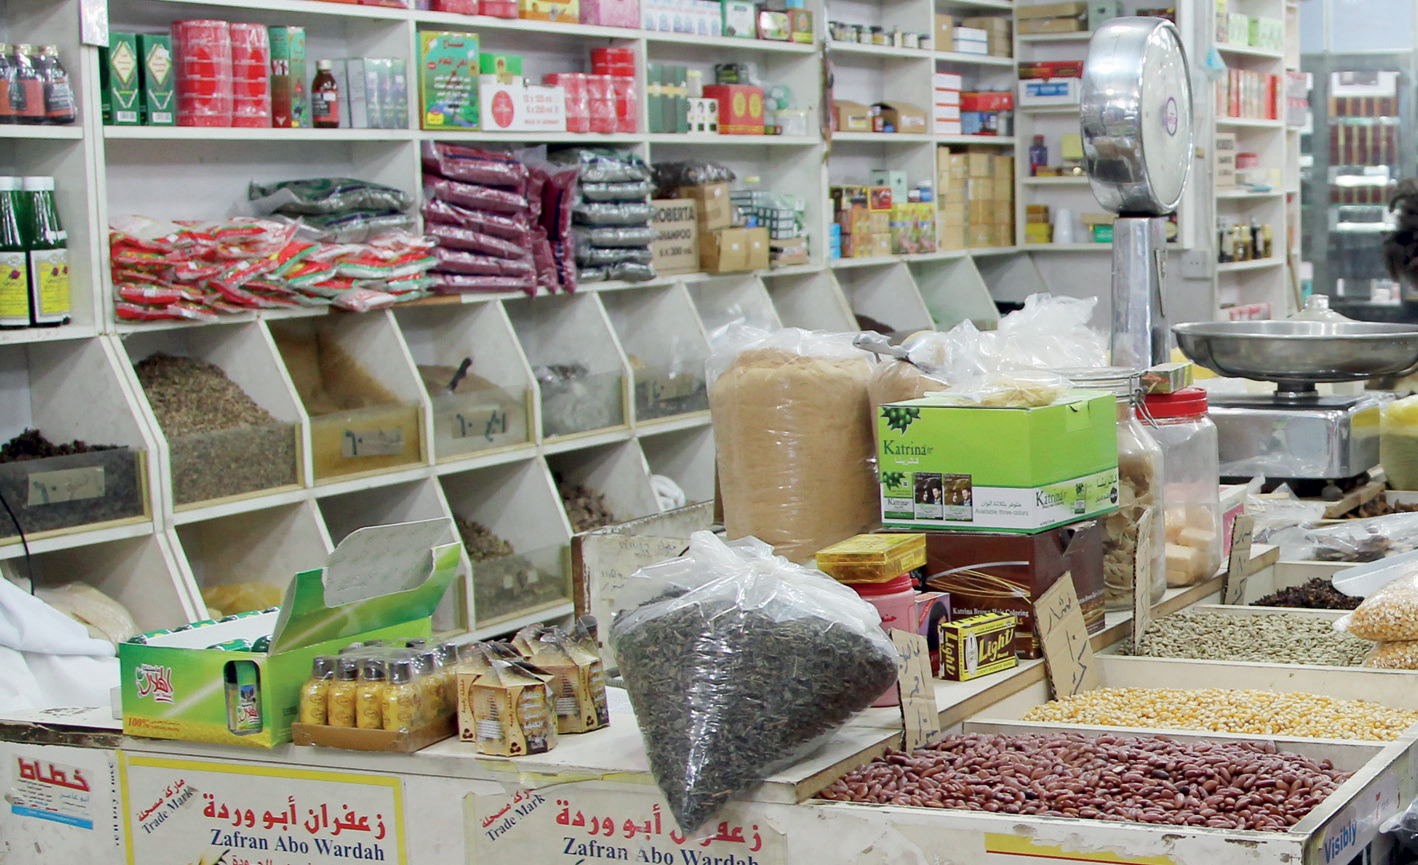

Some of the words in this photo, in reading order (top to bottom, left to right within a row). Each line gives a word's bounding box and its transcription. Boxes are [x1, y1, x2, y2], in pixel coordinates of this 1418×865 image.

[883, 440, 927, 456] Katrina
[952, 607, 974, 615] Katrina
[18, 757, 91, 792] خطاط
[141, 808, 170, 836] Trade
[169, 788, 194, 816] Mark
[203, 793, 256, 829] وردة
[262, 796, 297, 832] أبو
[304, 803, 387, 841] زعفران
[485, 817, 516, 843] Trade
[515, 794, 546, 820] Mark
[555, 799, 615, 836] وردة
[623, 803, 662, 840] أبو
[210, 828, 269, 851] Zafran
[274, 836, 309, 855] Abo
[313, 838, 386, 862] Wardah
[562, 837, 628, 861] Zafran
[635, 845, 675, 865] Abo
[680, 848, 760, 865] Wardah
[1324, 820, 1358, 864] Visibly
